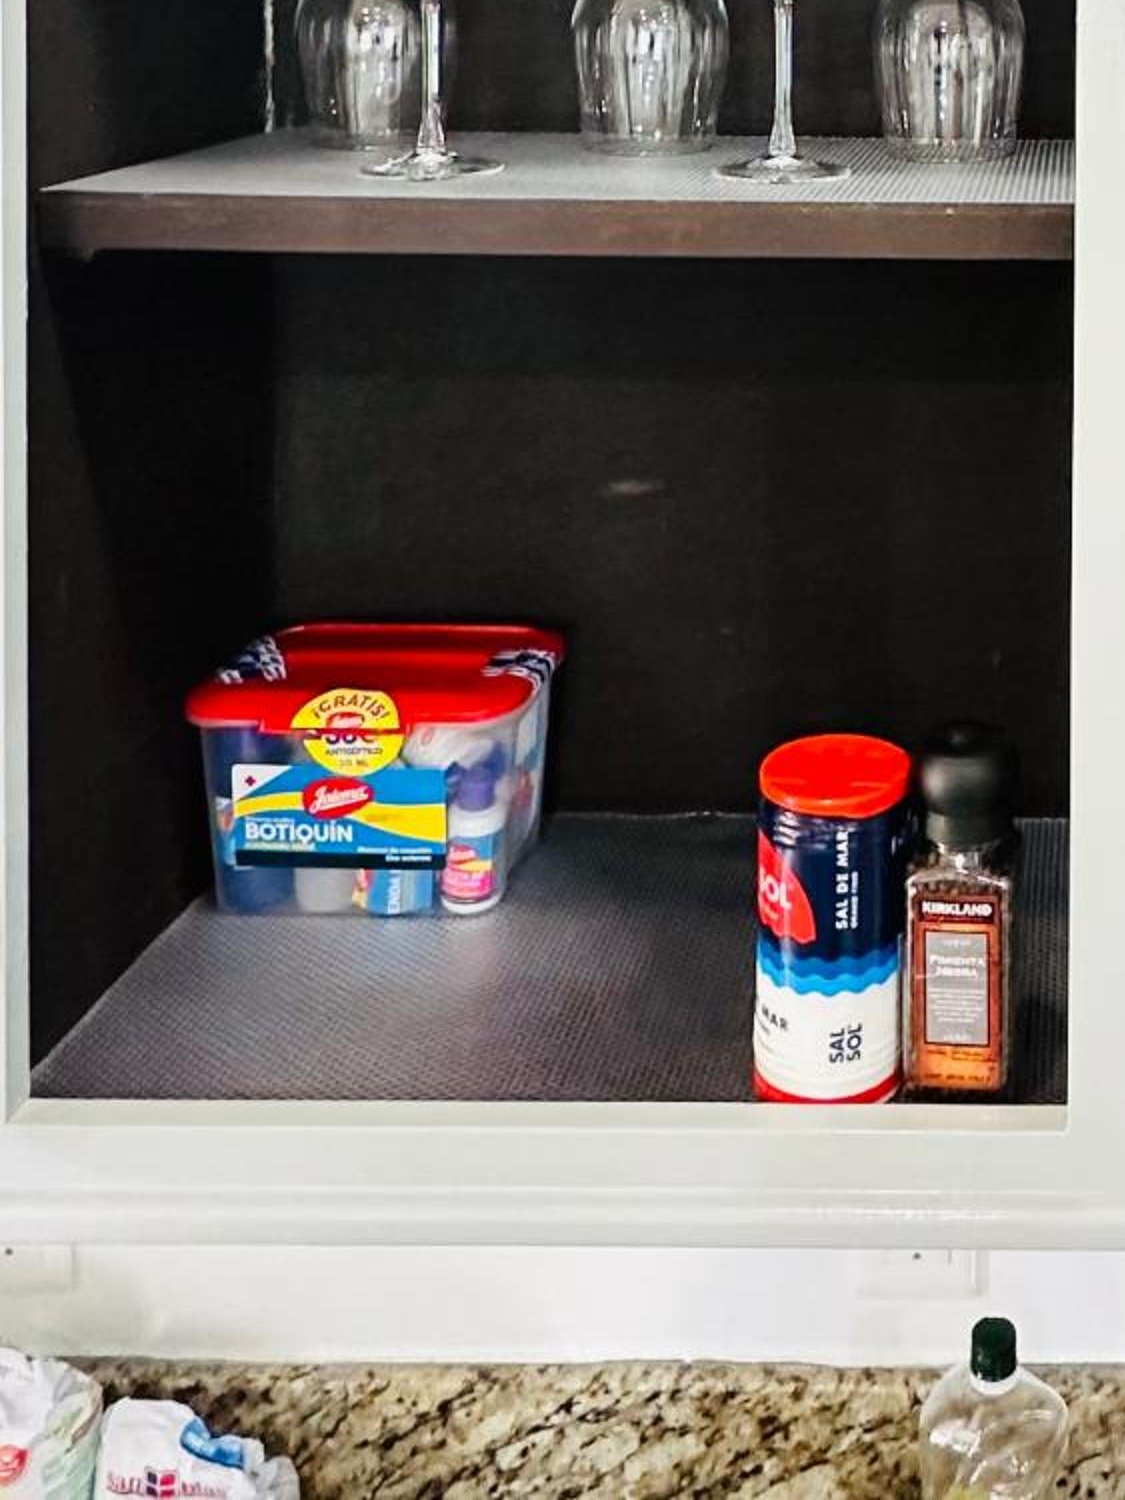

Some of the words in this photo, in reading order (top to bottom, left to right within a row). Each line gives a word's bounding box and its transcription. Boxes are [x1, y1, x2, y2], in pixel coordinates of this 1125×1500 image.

[245, 819, 354, 845] BOTIQUÍN
[835, 828, 849, 868] MAR
[835, 873, 849, 895] DE
[835, 898, 849, 931] SAL
[922, 900, 993, 917] KIRKLAND
[829, 1028, 845, 1064] SAL
[846, 1022, 863, 1062] SOL
